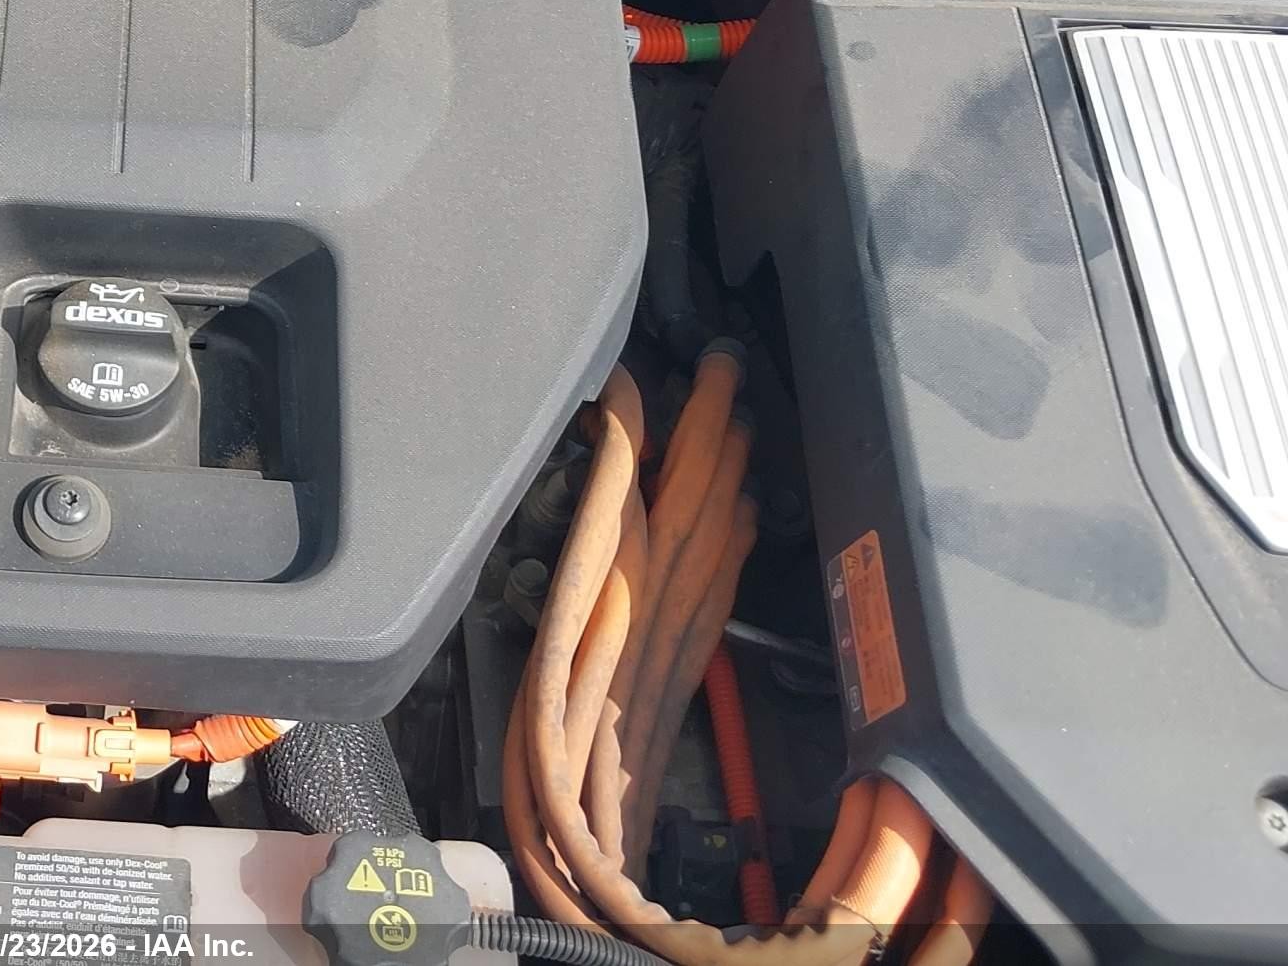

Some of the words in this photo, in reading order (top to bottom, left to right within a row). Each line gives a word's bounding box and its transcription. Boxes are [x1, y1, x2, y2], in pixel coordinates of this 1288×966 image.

[65, 301, 168, 328] dexos
[67, 377, 96, 400] SAE
[99, 383, 150, 403] 5W-30
[16, 851, 26, 861] To
[27, 853, 50, 862] avoid
[51, 855, 87, 865] damage,
[88, 858, 104, 866] use
[105, 859, 123, 868] only
[372, 847, 385, 856] 35
[386, 848, 405, 859] kPa
[15, 862, 54, 872] premixed
[55, 864, 80, 874] 50/50
[82, 866, 100, 876] with
[102, 868, 146, 878] de-ionized
[376, 857, 384, 867] 5
[385, 858, 402, 868] PSI
[14, 872, 26, 881] No
[27, 873, 68, 884] additives,
[69, 876, 100, 885] sealant
[101, 879, 111, 887] or
[112, 879, 127, 889] tap
[13, 886, 33, 897] Pour
[59, 889, 78, 899] tout
[11, 898, 28, 908] que
[29, 898, 40, 907] du
[138, 906, 160, 916] parts
[40, 910, 61, 920] avec
[62, 910, 74, 920] de
[10, 918, 26, 927] Pas
